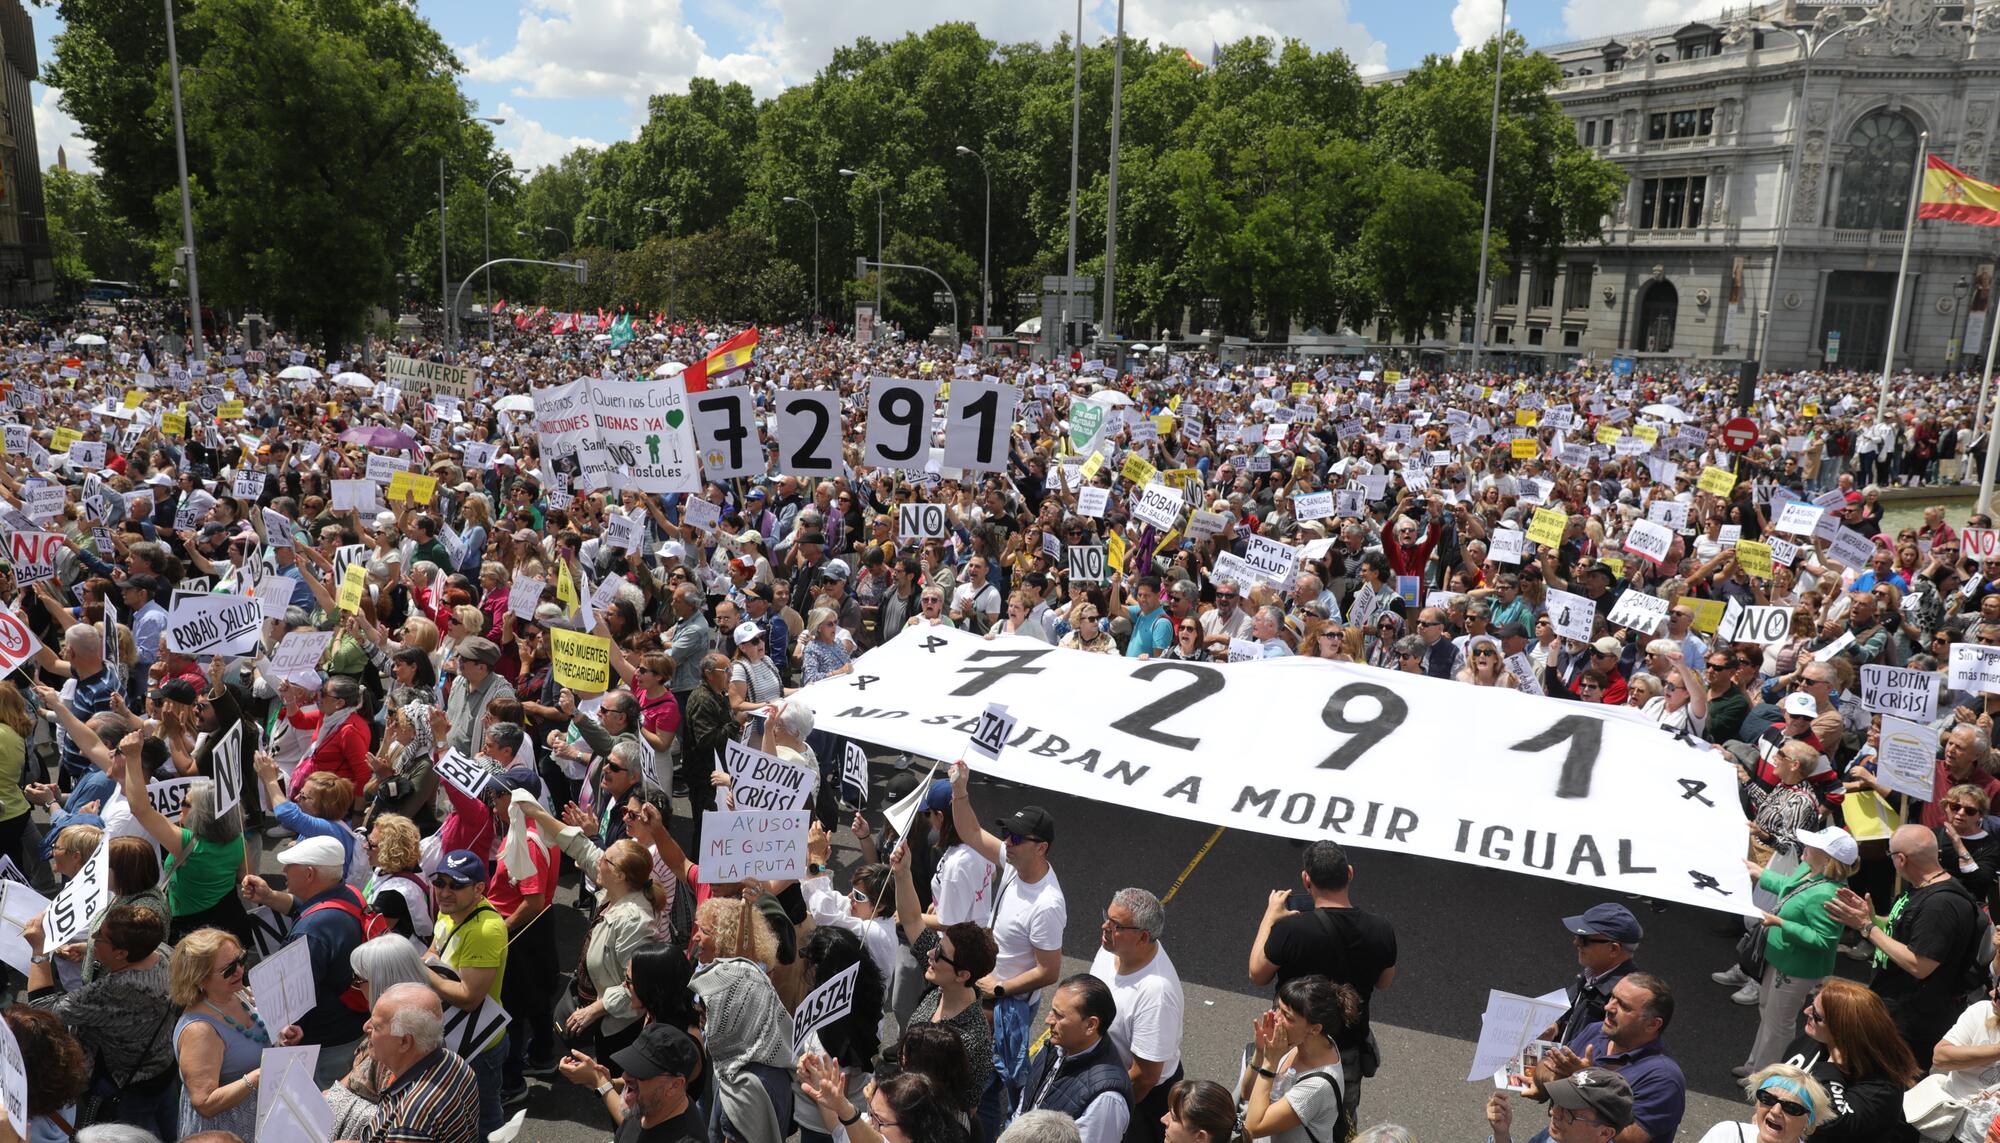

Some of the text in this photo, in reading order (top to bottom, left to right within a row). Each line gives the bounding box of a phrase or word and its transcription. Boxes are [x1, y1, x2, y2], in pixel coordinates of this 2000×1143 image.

[389, 358, 469, 385] VILLAVERDE
[5, 391, 23, 410] NO
[435, 384, 451, 397] POR
[580, 391, 589, 405] a
[592, 387, 626, 409] Quien
[628, 398, 645, 409] nos
[649, 386, 681, 409] Cuida
[594, 414, 639, 431] DIGNAS
[698, 387, 999, 470] 7 2 9 1
[237, 471, 248, 480] SE
[237, 482, 247, 493] TU
[1138, 503, 1149, 514] TU
[1144, 490, 1179, 517] ROBAN
[901, 507, 945, 536] NO
[1249, 538, 1292, 561] ¡Por la
[1962, 529, 1996, 557] NO
[1070, 547, 1102, 579] NO
[1246, 553, 1289, 577] SALUD!
[1738, 608, 1788, 642] NO
[575, 643, 608, 665] MUERTES
[1958, 648, 1973, 661] Sin
[1864, 668, 1881, 686] TU
[1958, 668, 1977, 682] más
[948, 648, 1605, 799] 7 2 9 1
[215, 728, 242, 813] NO
[729, 749, 750, 772] TU
[834, 706, 911, 719] NO
[1006, 726, 1153, 786] IBAN
[1163, 775, 1203, 804] A
[1231, 785, 1420, 844] MORIR
[1454, 818, 1658, 877] IGUAL
[732, 816, 801, 833] AYUSO:
[711, 838, 797, 858] ME GUSTA
[718, 858, 796, 879] LA FRUTA
[794, 970, 859, 1039] BASTA!
